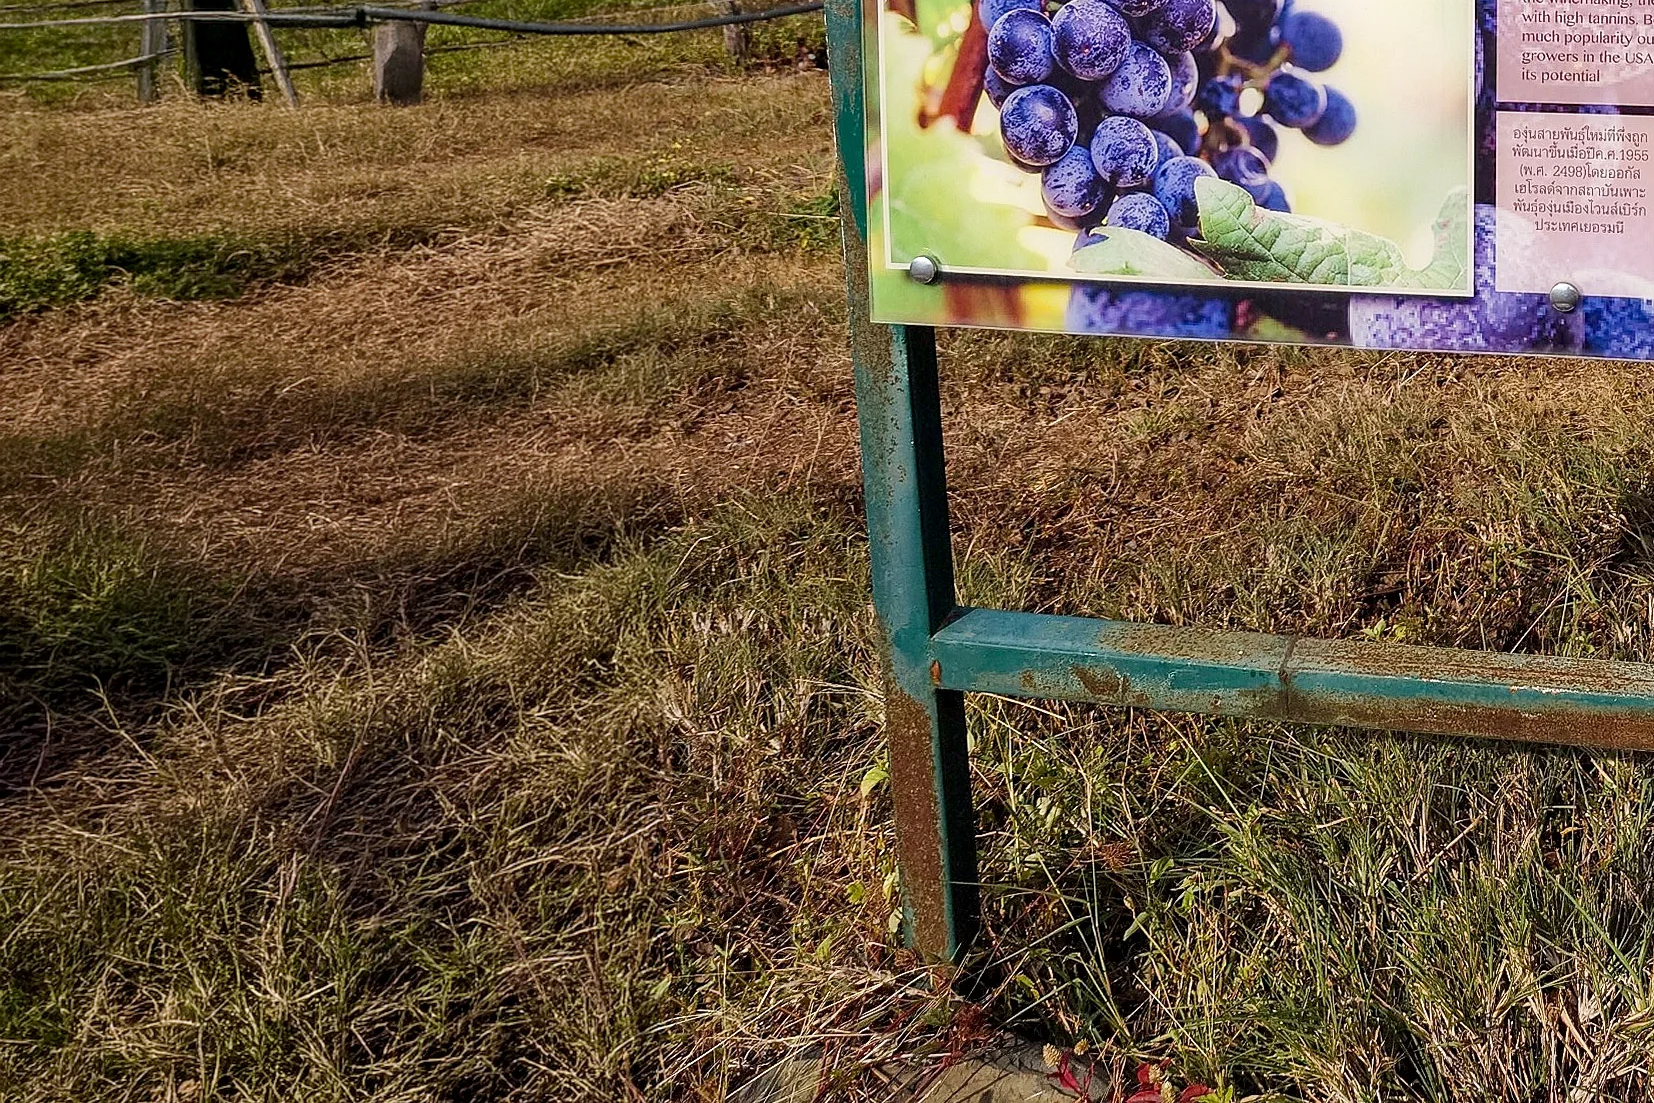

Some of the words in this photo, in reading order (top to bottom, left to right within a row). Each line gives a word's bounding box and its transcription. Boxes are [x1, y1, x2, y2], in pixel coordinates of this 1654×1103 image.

[1522, 11, 1550, 23] with
[1555, 11, 1583, 26] high
[1588, 13, 1638, 25] tannins.
[1522, 31, 1559, 43] much
[1564, 32, 1633, 47] popularity
[1522, 52, 1578, 63] growers
[1583, 50, 1594, 62] in
[1600, 51, 1620, 63] the
[1522, 68, 1537, 81] its
[1541, 70, 1600, 83] potential
[1535, 218, 1624, 234] ประเทศเยอรมนี
